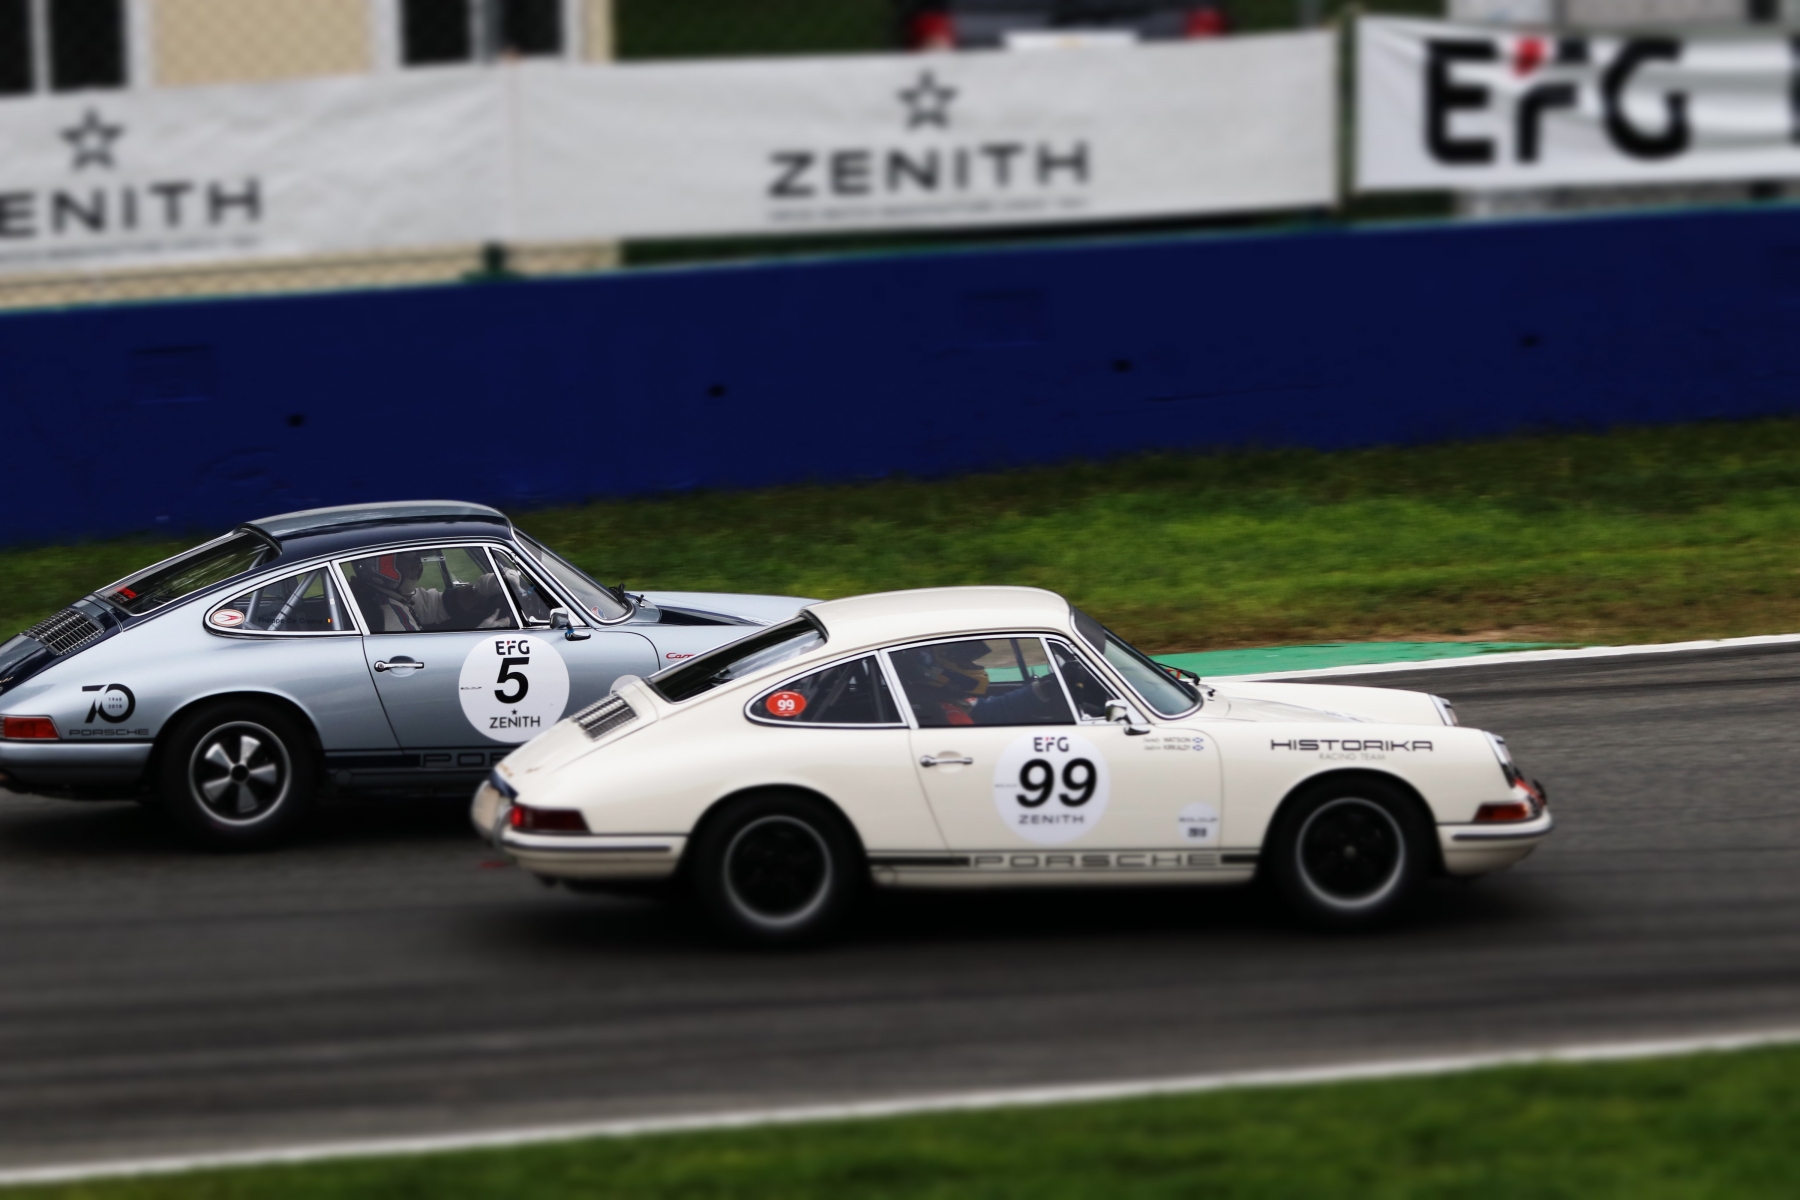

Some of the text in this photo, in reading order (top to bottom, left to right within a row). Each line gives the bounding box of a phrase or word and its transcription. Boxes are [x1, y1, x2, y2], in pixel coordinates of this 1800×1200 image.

[1423, 36, 1691, 165] EFG
[766, 140, 1091, 197] ZENITH
[495, 639, 530, 656] EFG
[494, 657, 530, 704] 5
[82, 683, 136, 724] 70
[777, 699, 795, 711] 99
[489, 716, 541, 729] ZENITH
[69, 728, 150, 736] PORSCHE
[1033, 736, 1070, 752] EFG
[1270, 739, 1433, 752] HISTORIKA
[1016, 757, 1097, 808] 99
[1018, 814, 1084, 825] ZENITH
[974, 854, 1218, 868] PORSCHE
